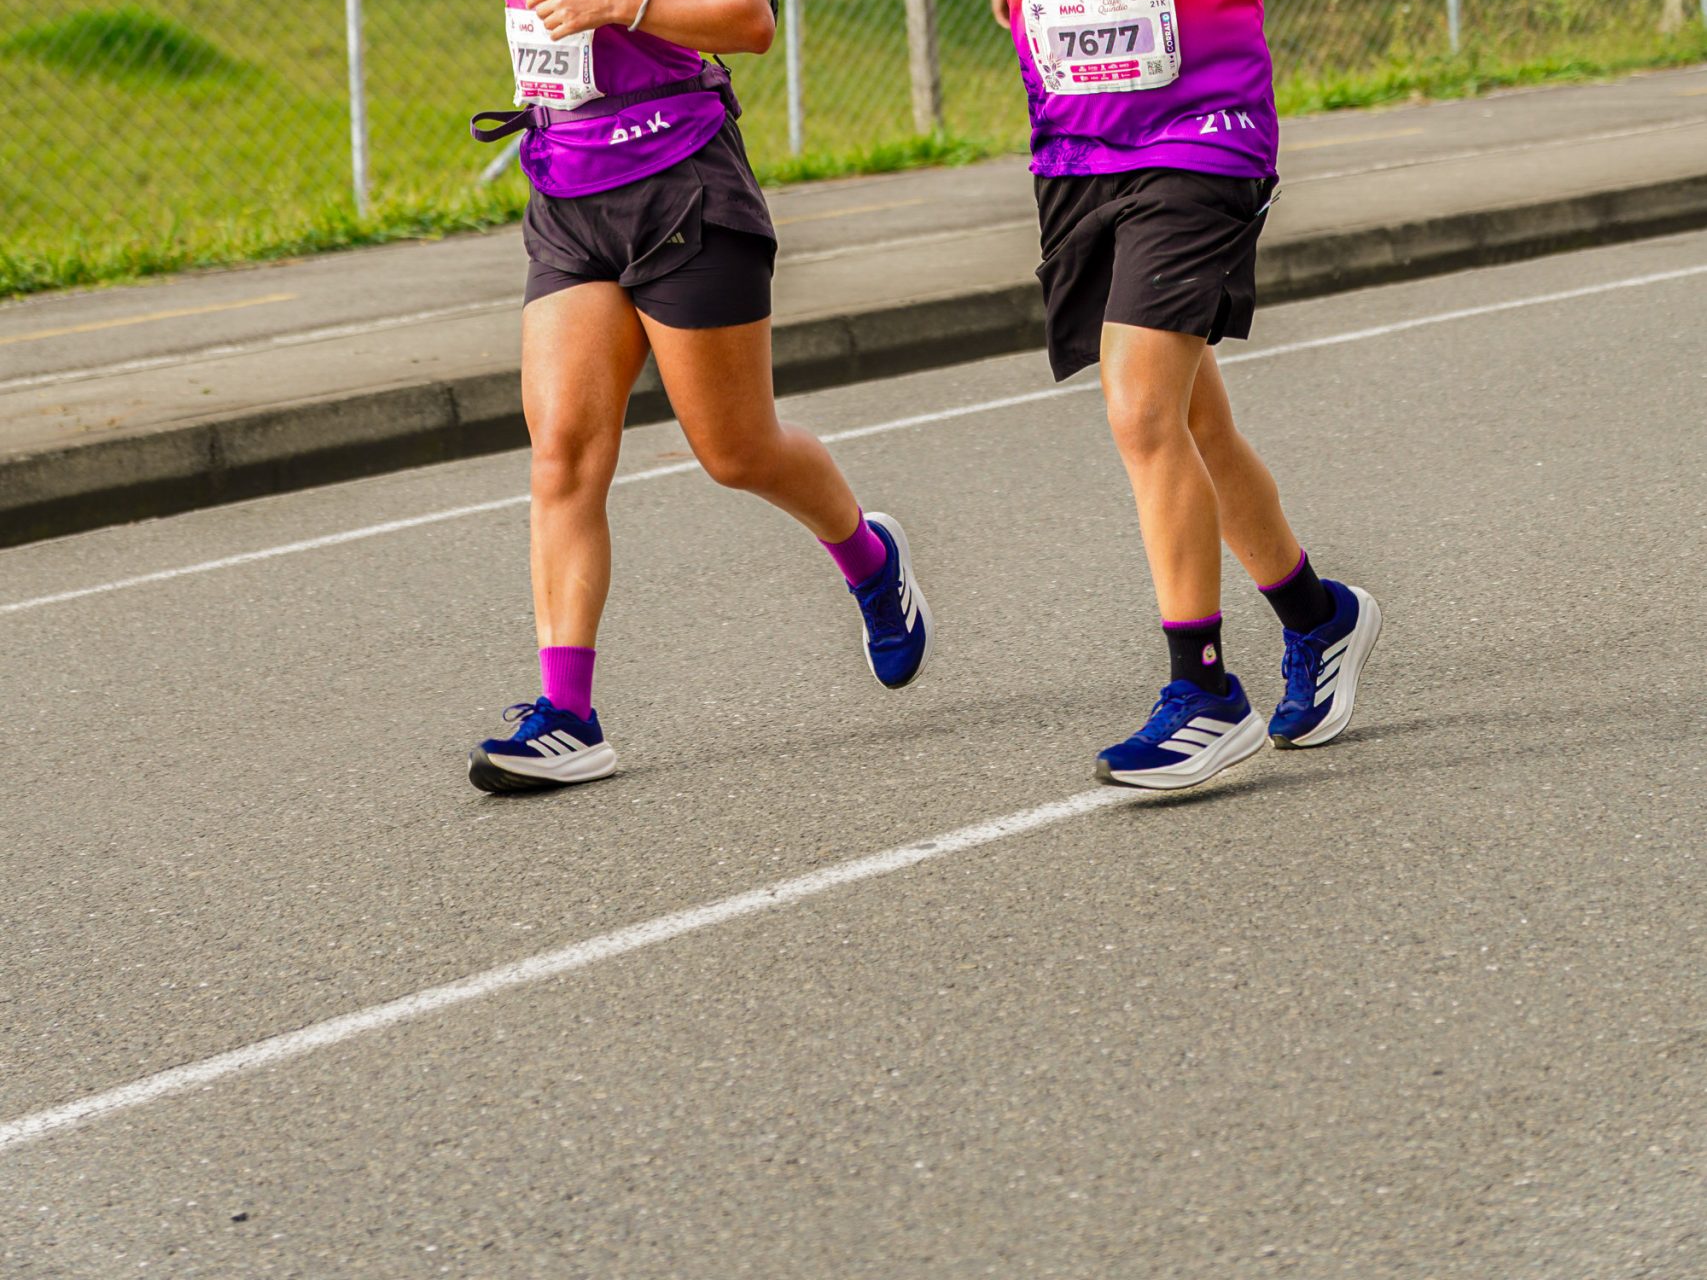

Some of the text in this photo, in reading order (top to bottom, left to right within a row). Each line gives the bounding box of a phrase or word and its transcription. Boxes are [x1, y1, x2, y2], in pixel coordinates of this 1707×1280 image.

[1059, 4, 1085, 16] MMQ
[1150, 0, 1167, 9] 21K
[1058, 24, 1140, 58] 7677
[1163, 22, 1174, 53] CORRAL
